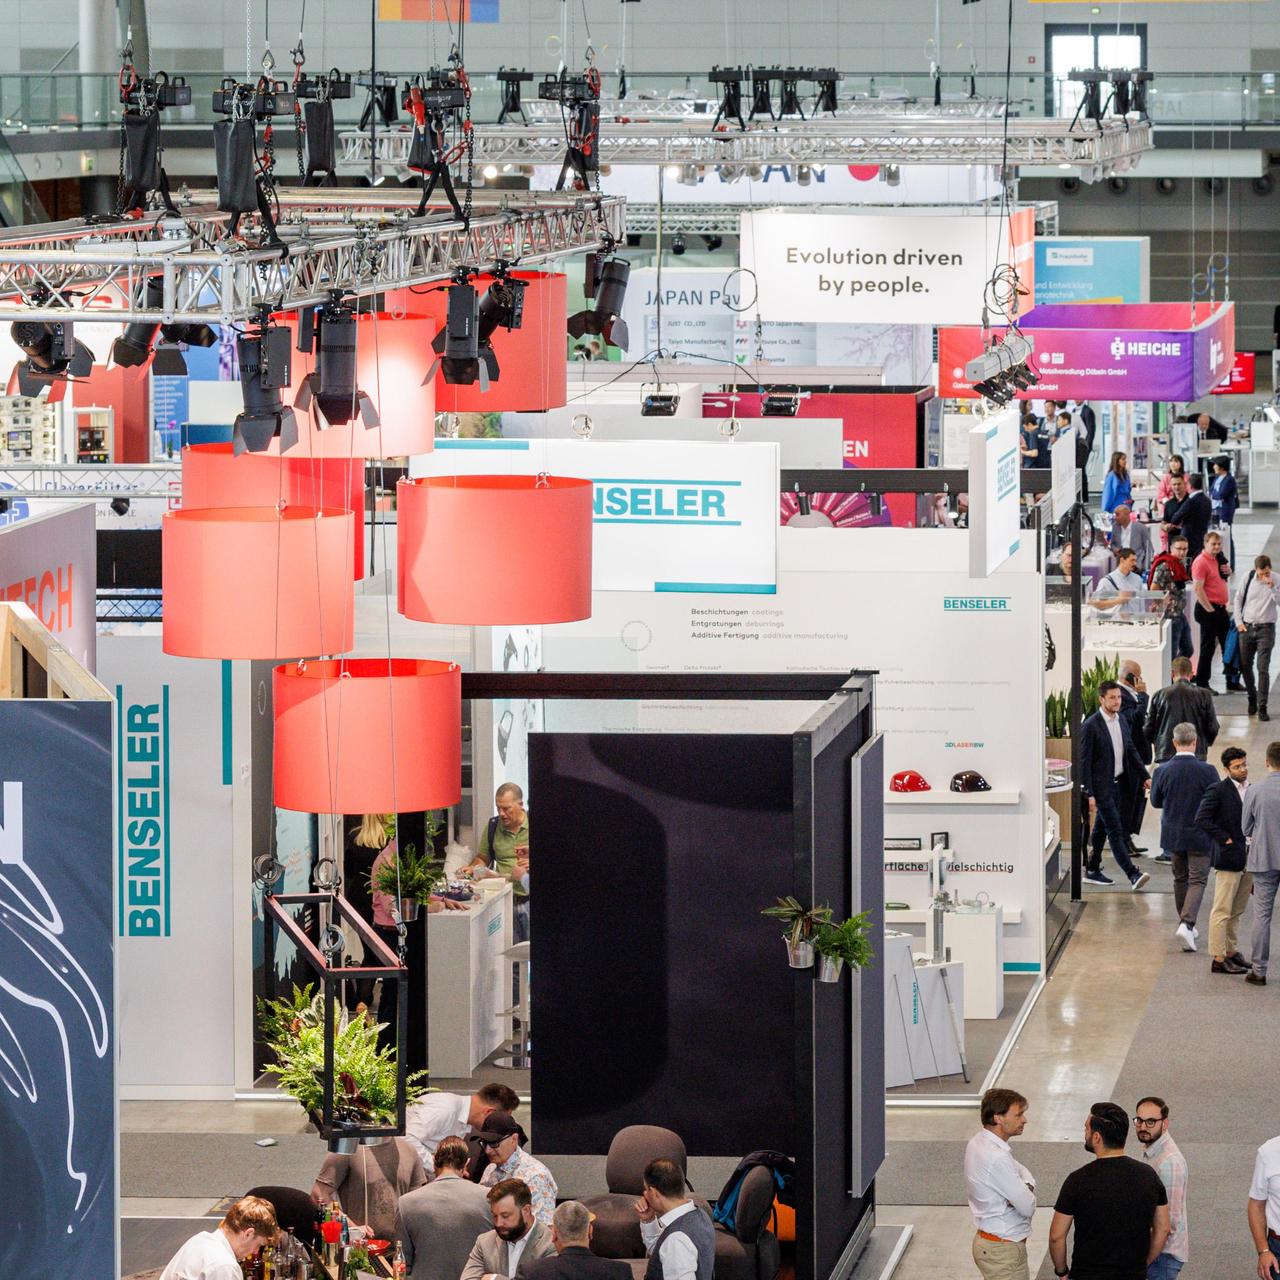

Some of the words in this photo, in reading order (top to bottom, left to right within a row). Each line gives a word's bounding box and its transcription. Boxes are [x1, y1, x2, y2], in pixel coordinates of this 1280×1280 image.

[786, 247, 887, 265] Evolution
[893, 249, 964, 266] driven
[819, 275, 844, 296] by
[851, 276, 930, 297] people.
[644, 289, 705, 306] JAPAN
[1128, 342, 1181, 356] HEICHE
[943, 600, 1006, 610] BENSELER
[691, 608, 748, 617] Beschichtungen
[691, 620, 742, 628] Entgratungen
[691, 631, 721, 639] Additive
[723, 631, 759, 640] Fertigung
[127, 703, 162, 936] BENSELER
